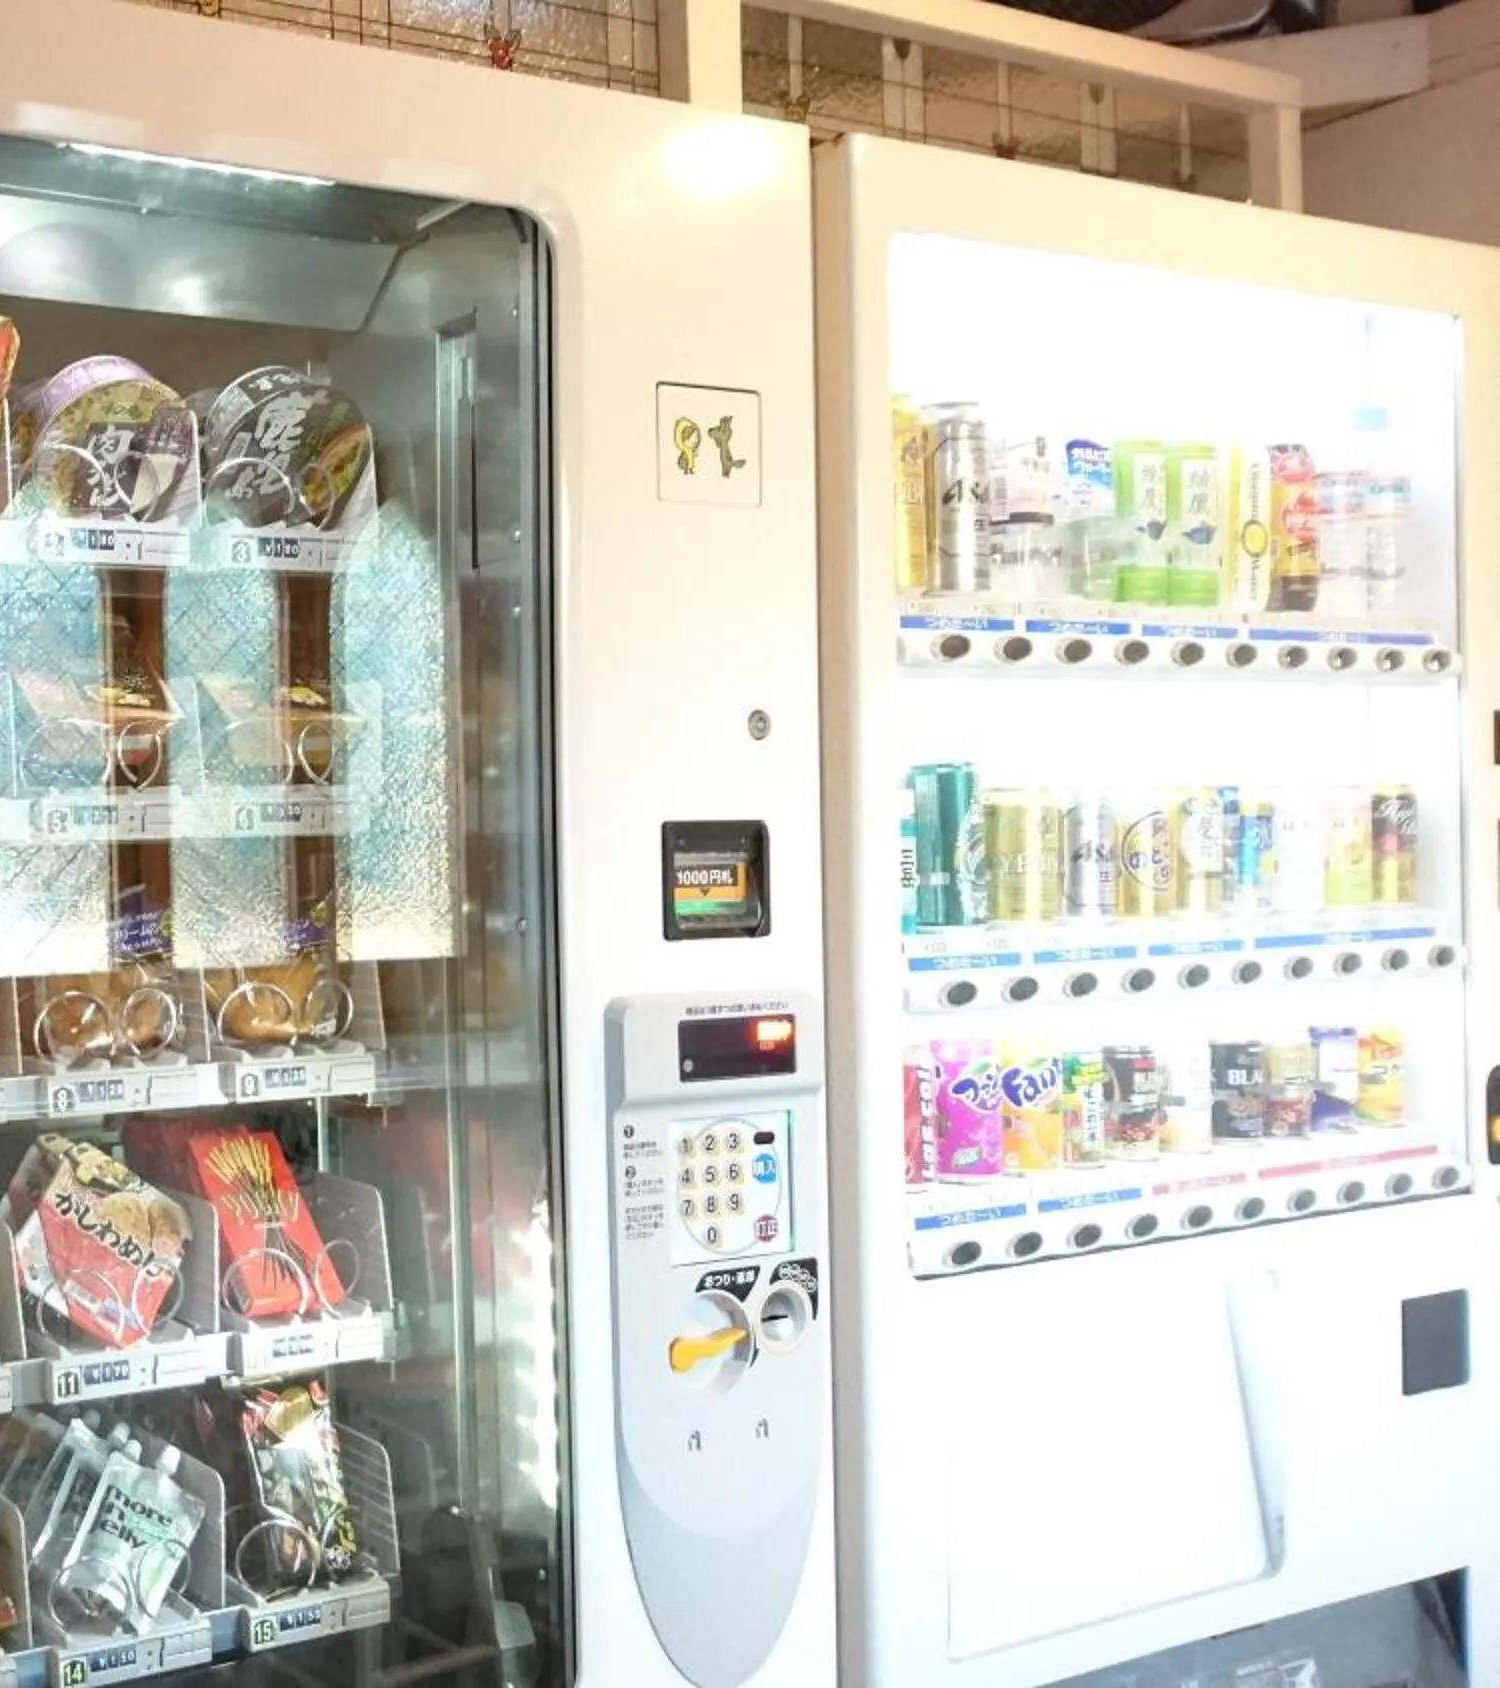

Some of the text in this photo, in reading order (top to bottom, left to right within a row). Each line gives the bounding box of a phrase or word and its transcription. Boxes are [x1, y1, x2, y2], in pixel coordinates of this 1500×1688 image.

[705, 1135, 716, 1151] 2
[729, 1133, 738, 1149] 3
[705, 1165, 716, 1183] 5
[729, 1163, 739, 1180] 6
[706, 1195, 715, 1213] 8
[729, 1193, 739, 1211] 9
[707, 1227, 716, 1244] 0
[58, 1371, 79, 1397] 11
[106, 1484, 174, 1526] more
[255, 1620, 275, 1645] 15
[64, 1660, 85, 1687] 14
